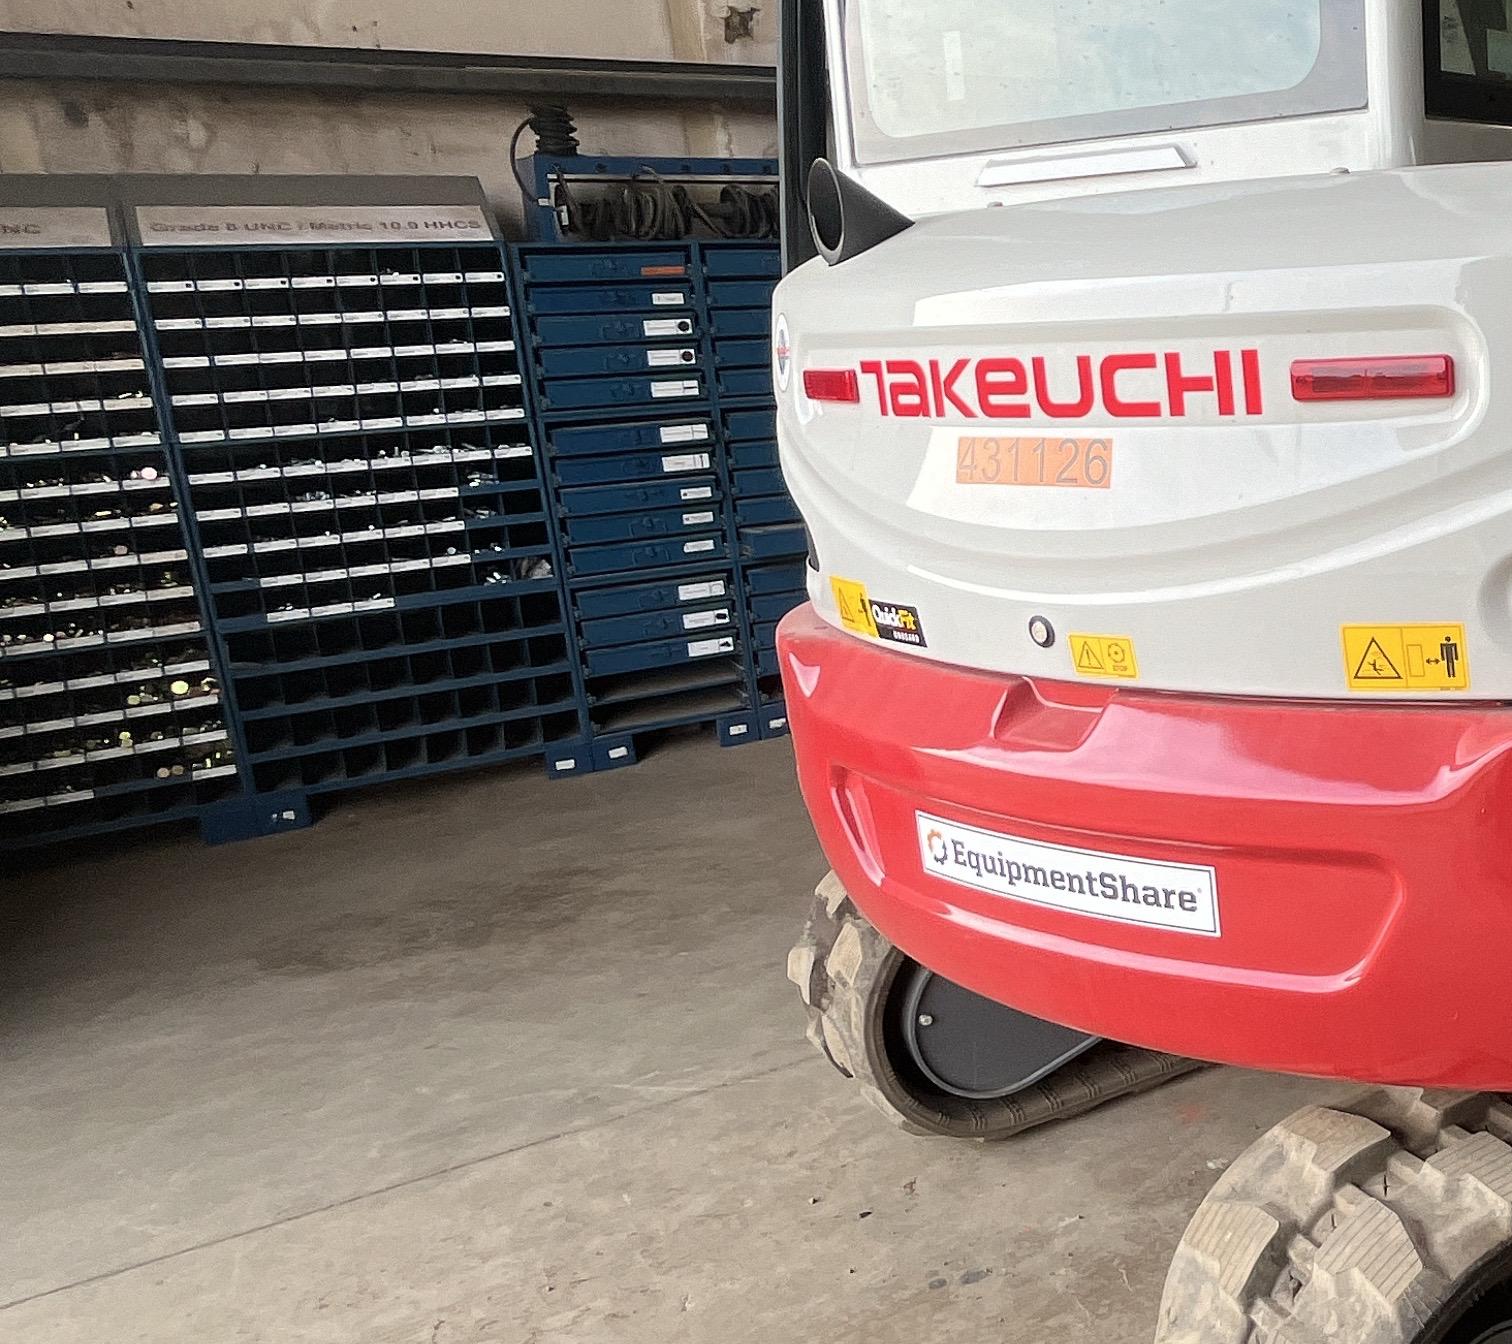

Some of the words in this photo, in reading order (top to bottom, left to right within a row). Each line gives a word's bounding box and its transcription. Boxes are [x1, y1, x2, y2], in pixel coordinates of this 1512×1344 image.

[859, 348, 1263, 419] TAKEUCHI
[957, 436, 1110, 487] 431126
[950, 838, 1198, 913] EquipmentShare
